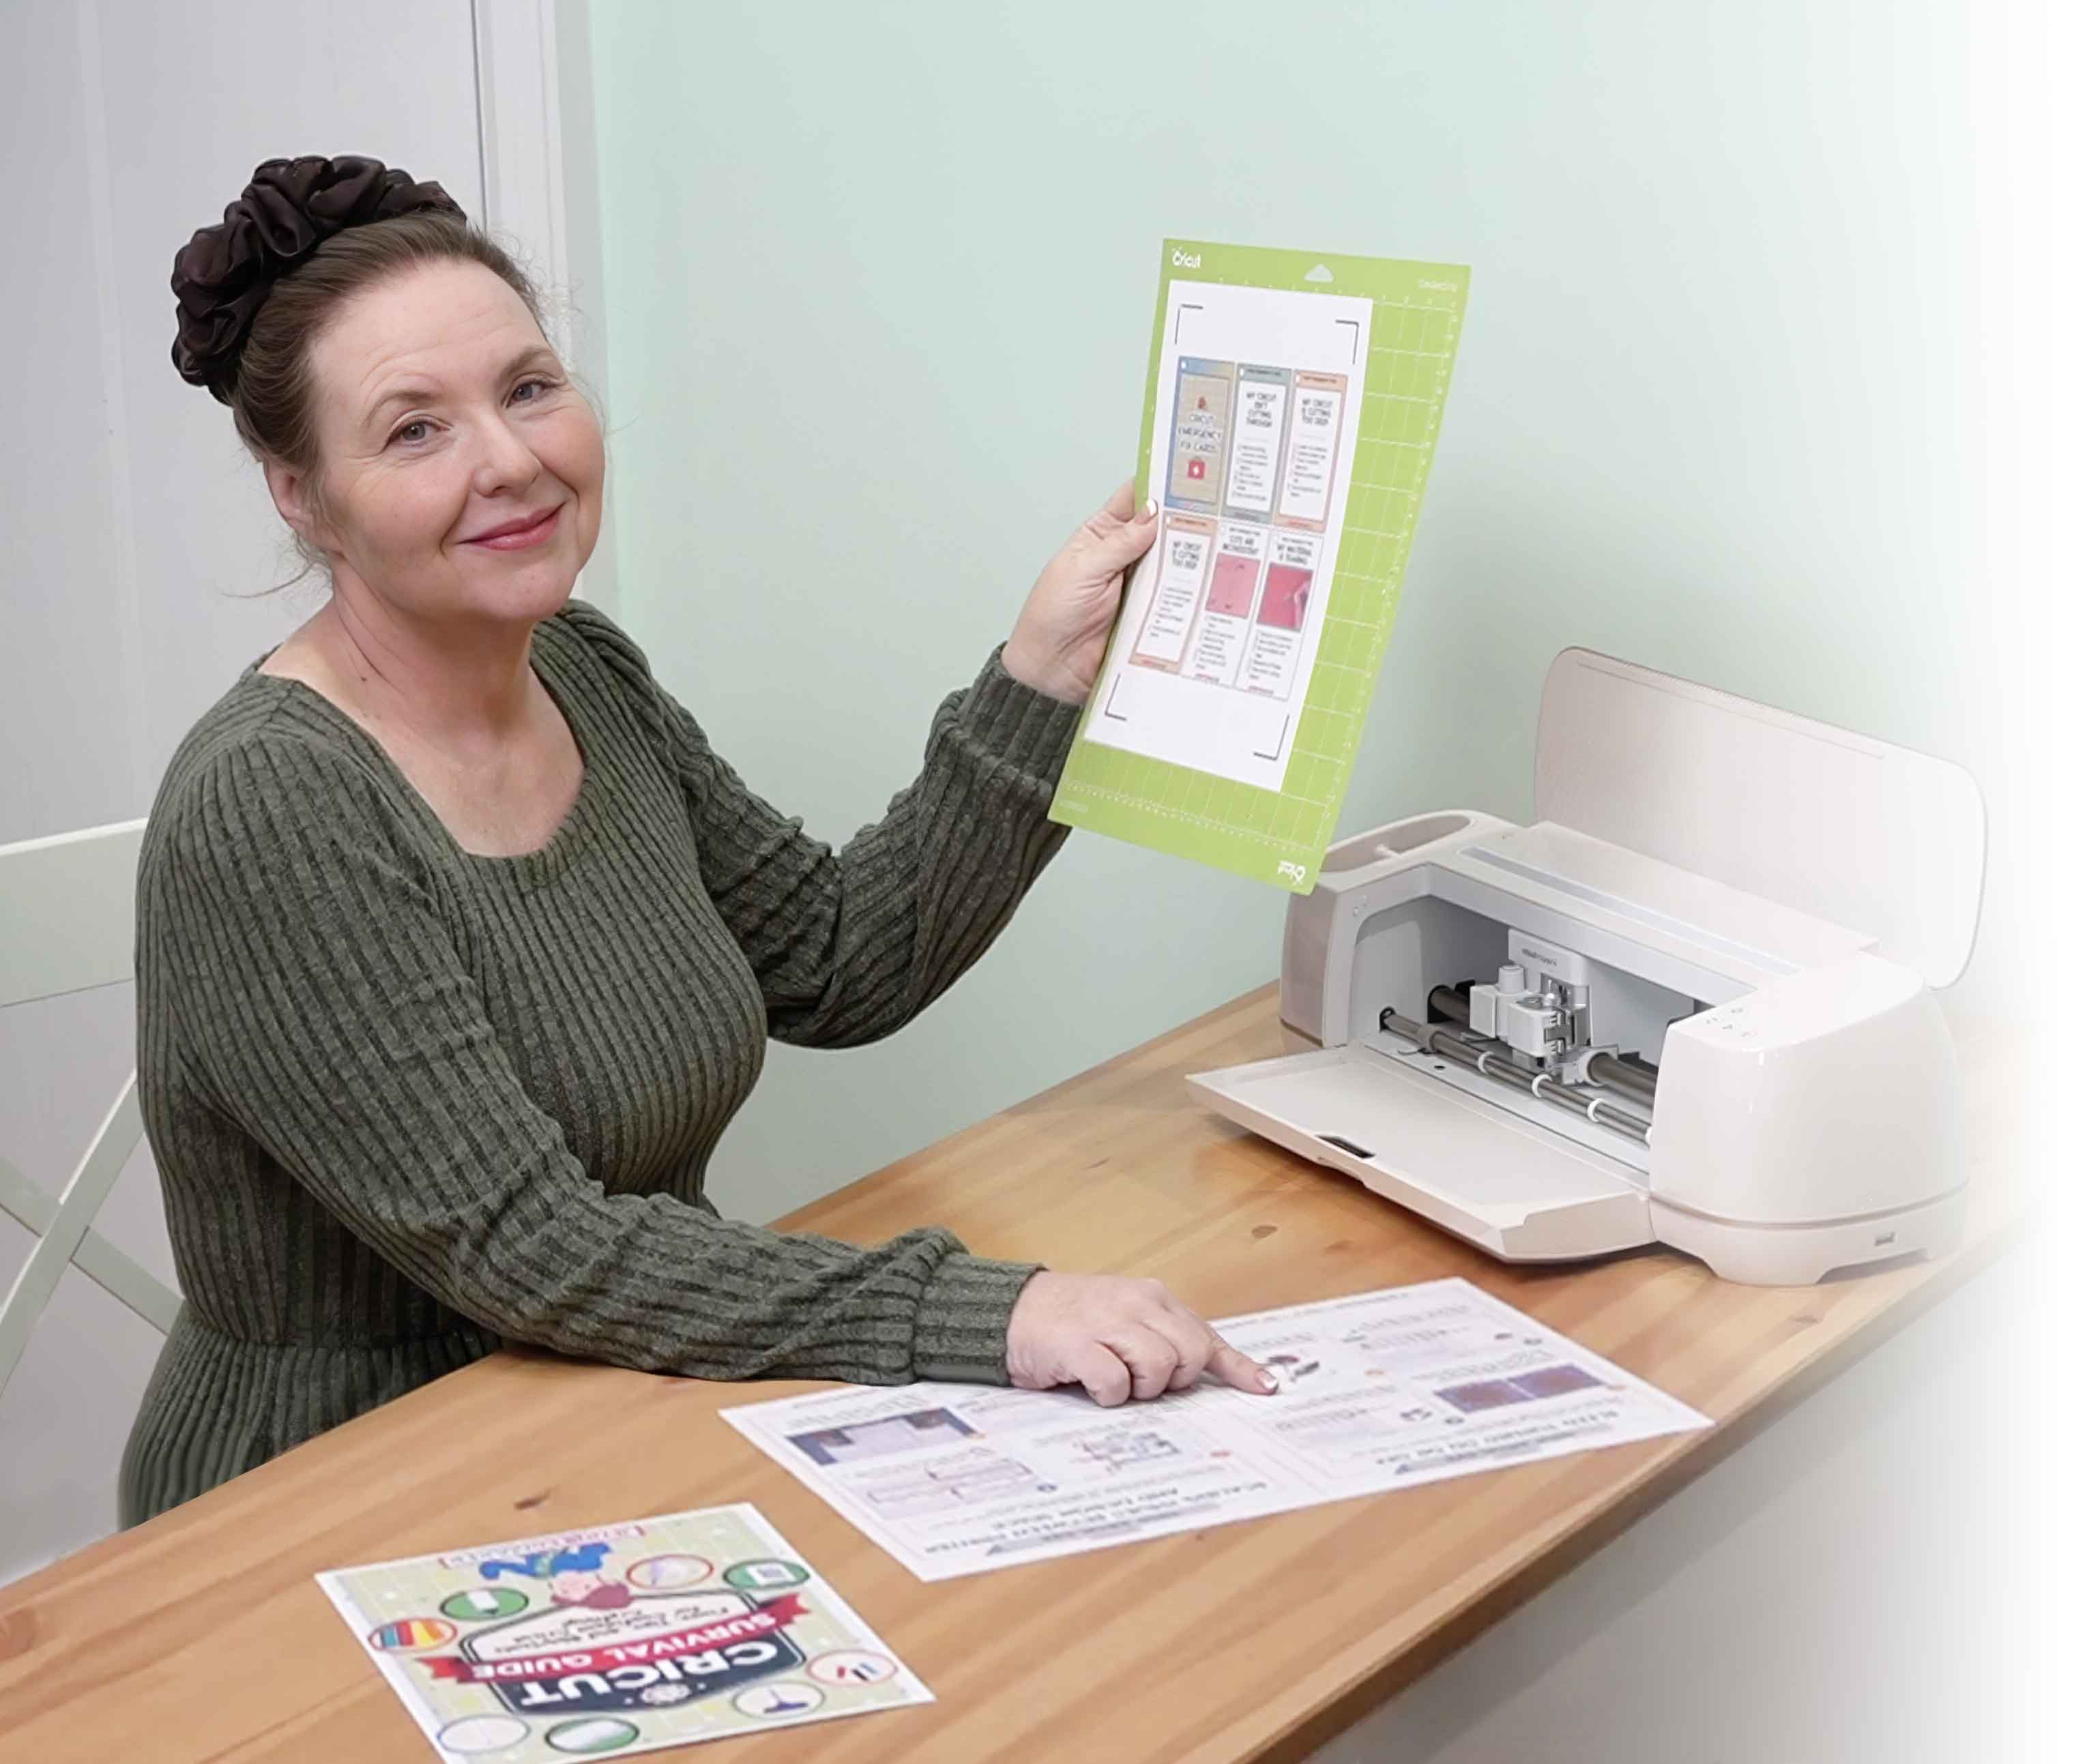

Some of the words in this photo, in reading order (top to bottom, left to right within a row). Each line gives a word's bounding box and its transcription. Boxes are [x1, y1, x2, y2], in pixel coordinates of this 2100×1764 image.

[602, 1612, 776, 1662] SURVIVAL
[472, 1653, 593, 1679] GUIDE
[520, 1641, 778, 1706] CRICUT
